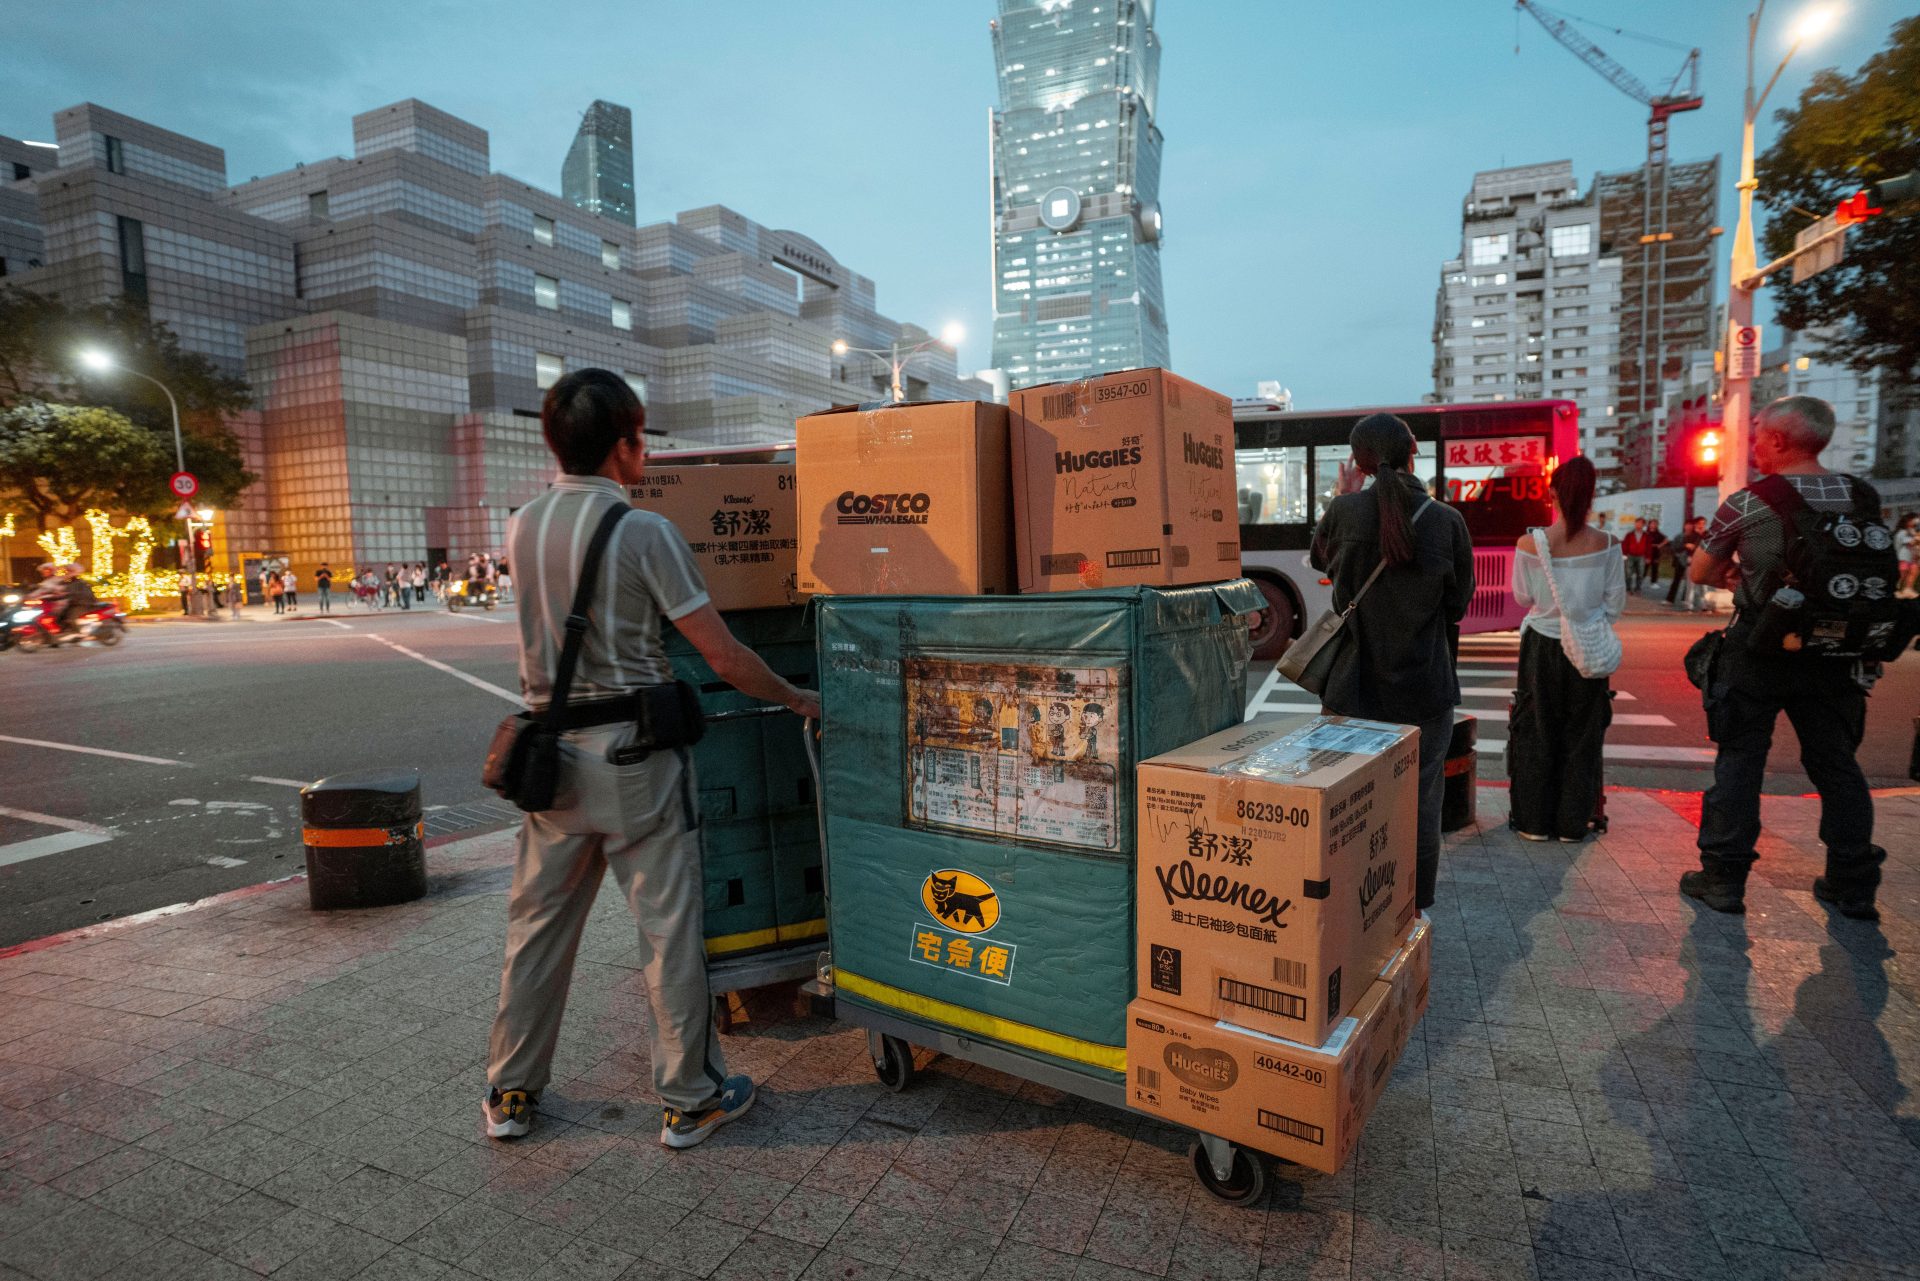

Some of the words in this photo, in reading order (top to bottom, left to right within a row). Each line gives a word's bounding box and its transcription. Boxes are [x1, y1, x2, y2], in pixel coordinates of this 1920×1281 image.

[1098, 382, 1147, 400] 39547-00
[1122, 435, 1141, 447] 好奇
[1183, 431, 1223, 470] HUGGIES
[1450, 440, 1540, 465] 欣欣客運
[1056, 446, 1142, 474] HUGGIES
[175, 480, 193, 490] 30
[778, 474, 797, 490] 81
[1063, 468, 1137, 499] Natural
[1448, 477, 1543, 502] 727-U3
[836, 490, 931, 514] COSTCO
[710, 509, 772, 537] 舒潔
[864, 514, 929, 525] WHOLESALE
[1236, 799, 1310, 828] 86239-00
[1185, 827, 1253, 867] 舒潔
[1155, 860, 1291, 928] Kleenex
[1359, 859, 1397, 919] Kleenex
[1170, 908, 1278, 944] 迪士尼袖珍包面紙
[916, 931, 1010, 978] 宅急便
[1171, 1051, 1229, 1082] HUGGIES
[1256, 1056, 1322, 1084] 40442-00
[1179, 1085, 1198, 1097] Baby
[1199, 1091, 1220, 1104] Wipes
